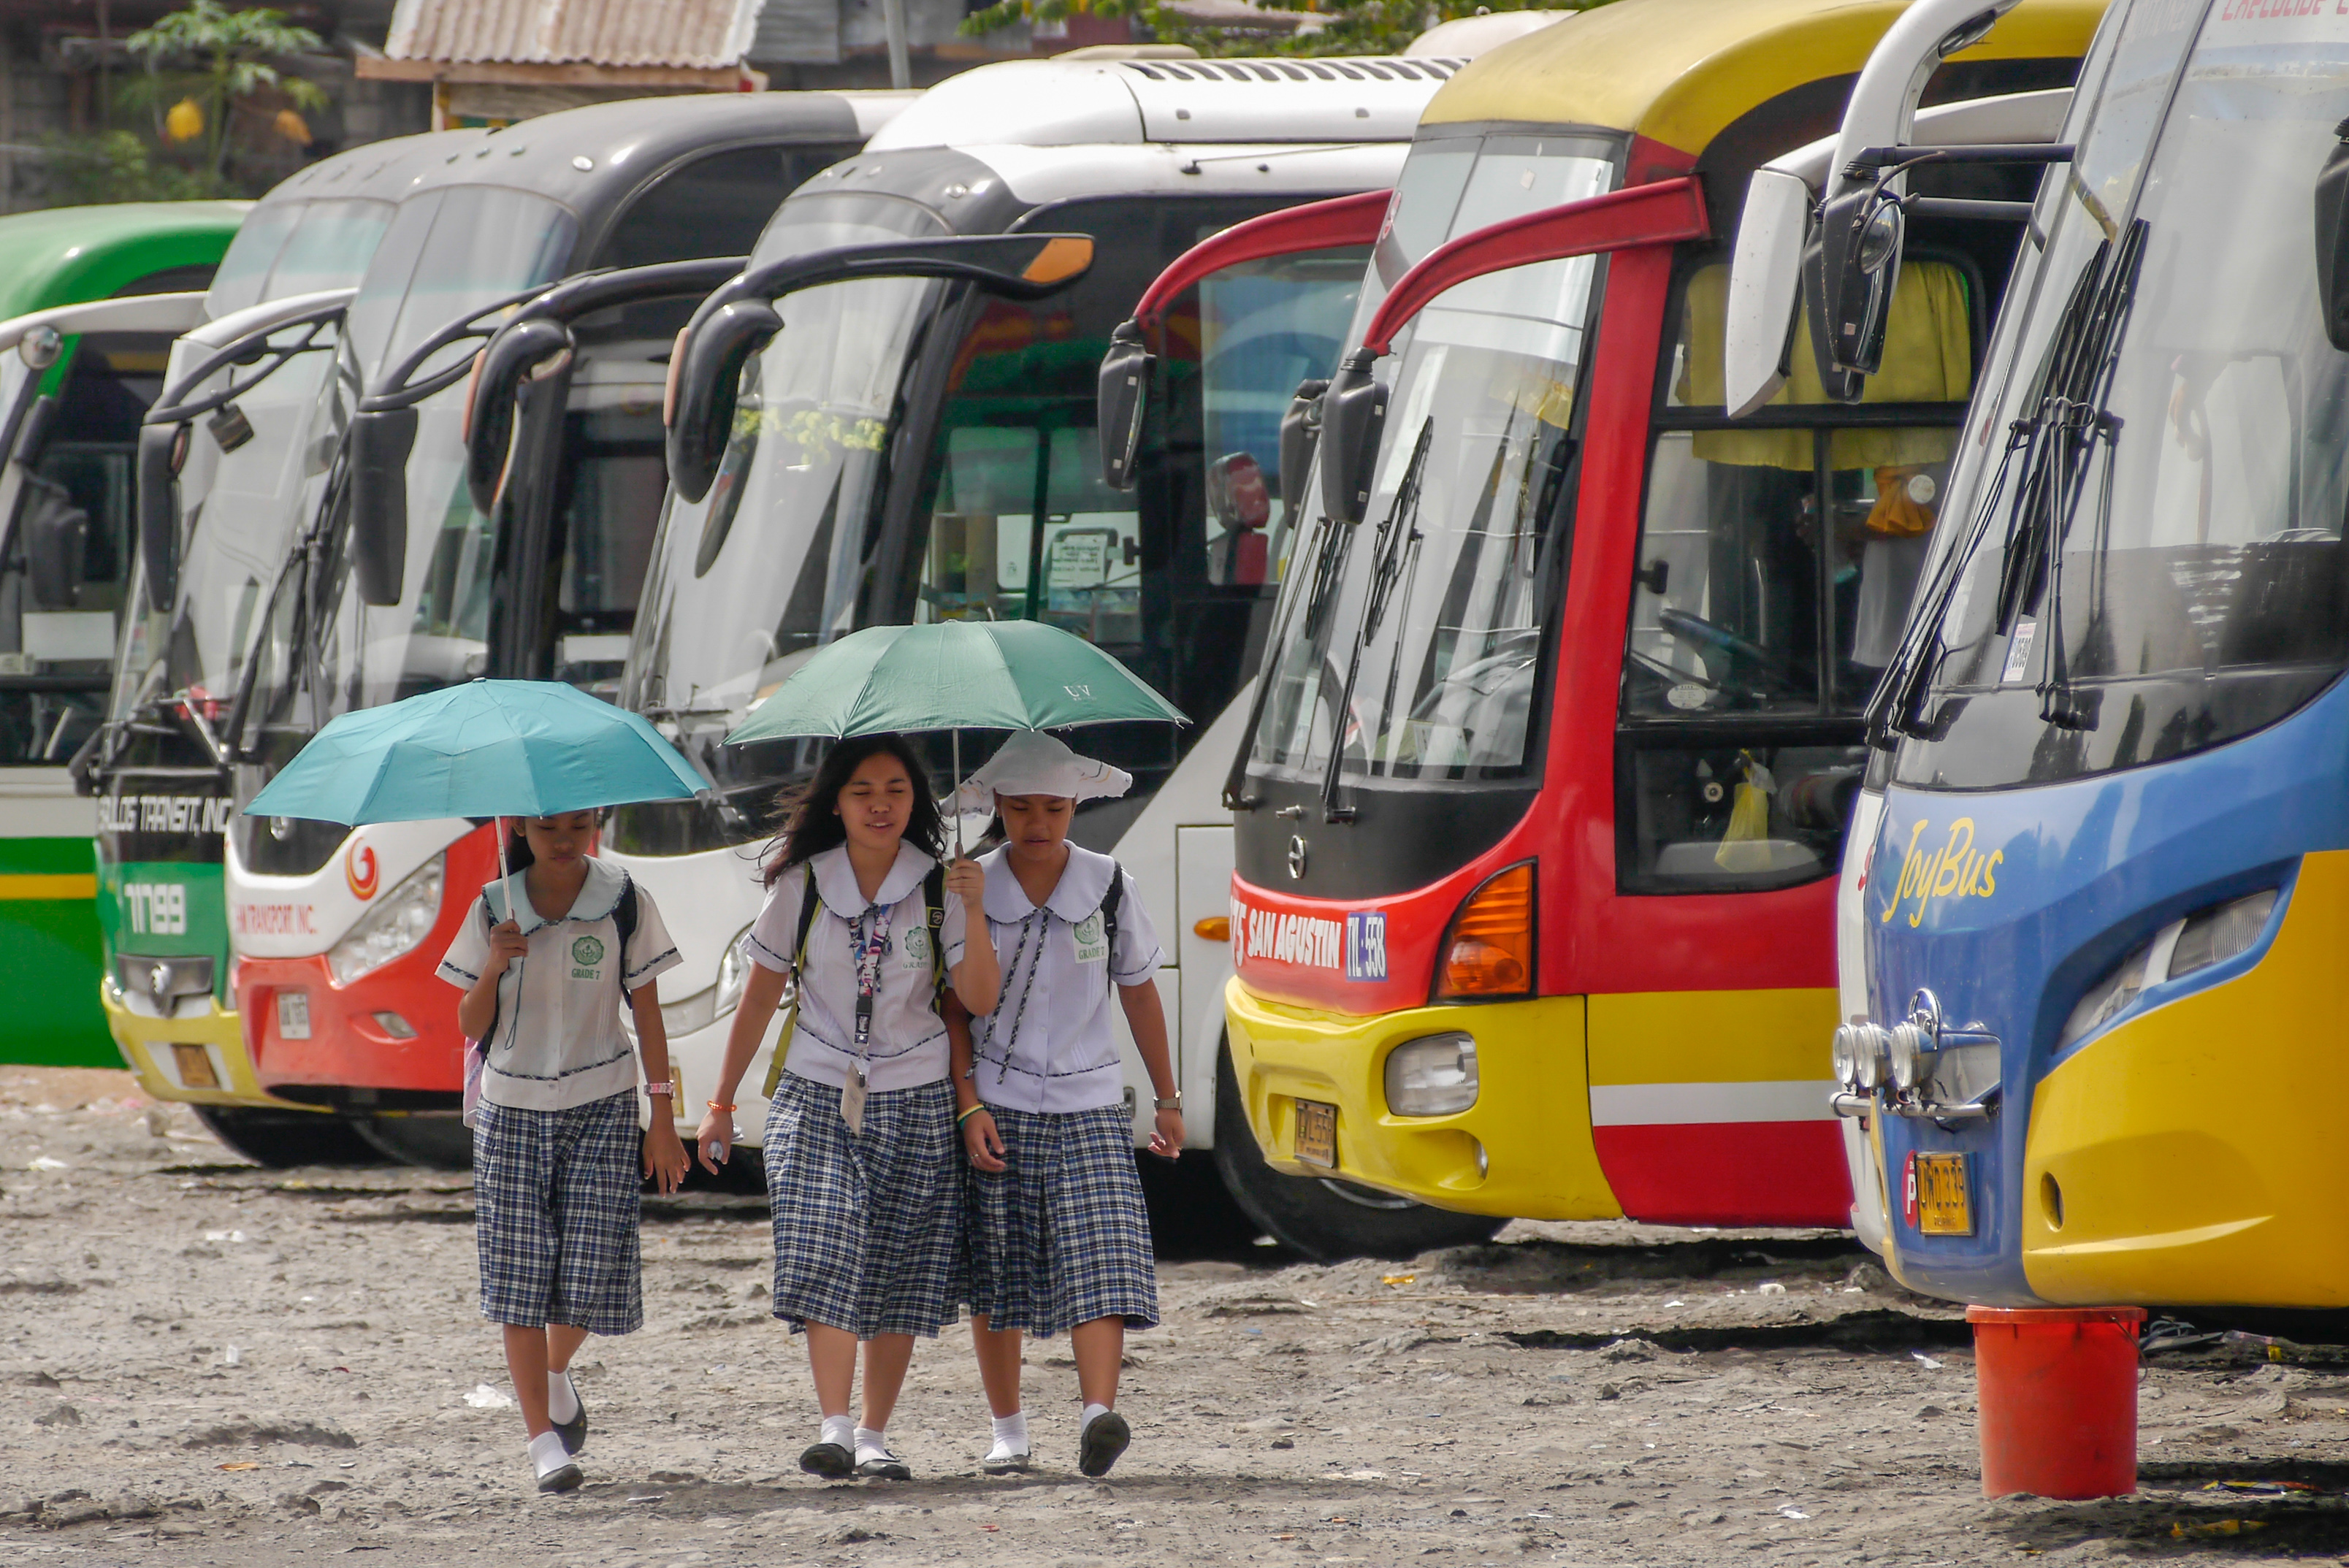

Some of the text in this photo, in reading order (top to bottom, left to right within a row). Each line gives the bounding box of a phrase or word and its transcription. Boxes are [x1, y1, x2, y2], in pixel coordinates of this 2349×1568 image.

[1882, 816, 2004, 928] JoyBus
[1078, 946, 1105, 960] GRADE 7
[1248, 909, 1276, 958] SAN
[1274, 914, 1342, 970] AGUSTIN
[571, 968, 600, 980] GRADE 7
[1906, 1174, 1917, 1214] P
